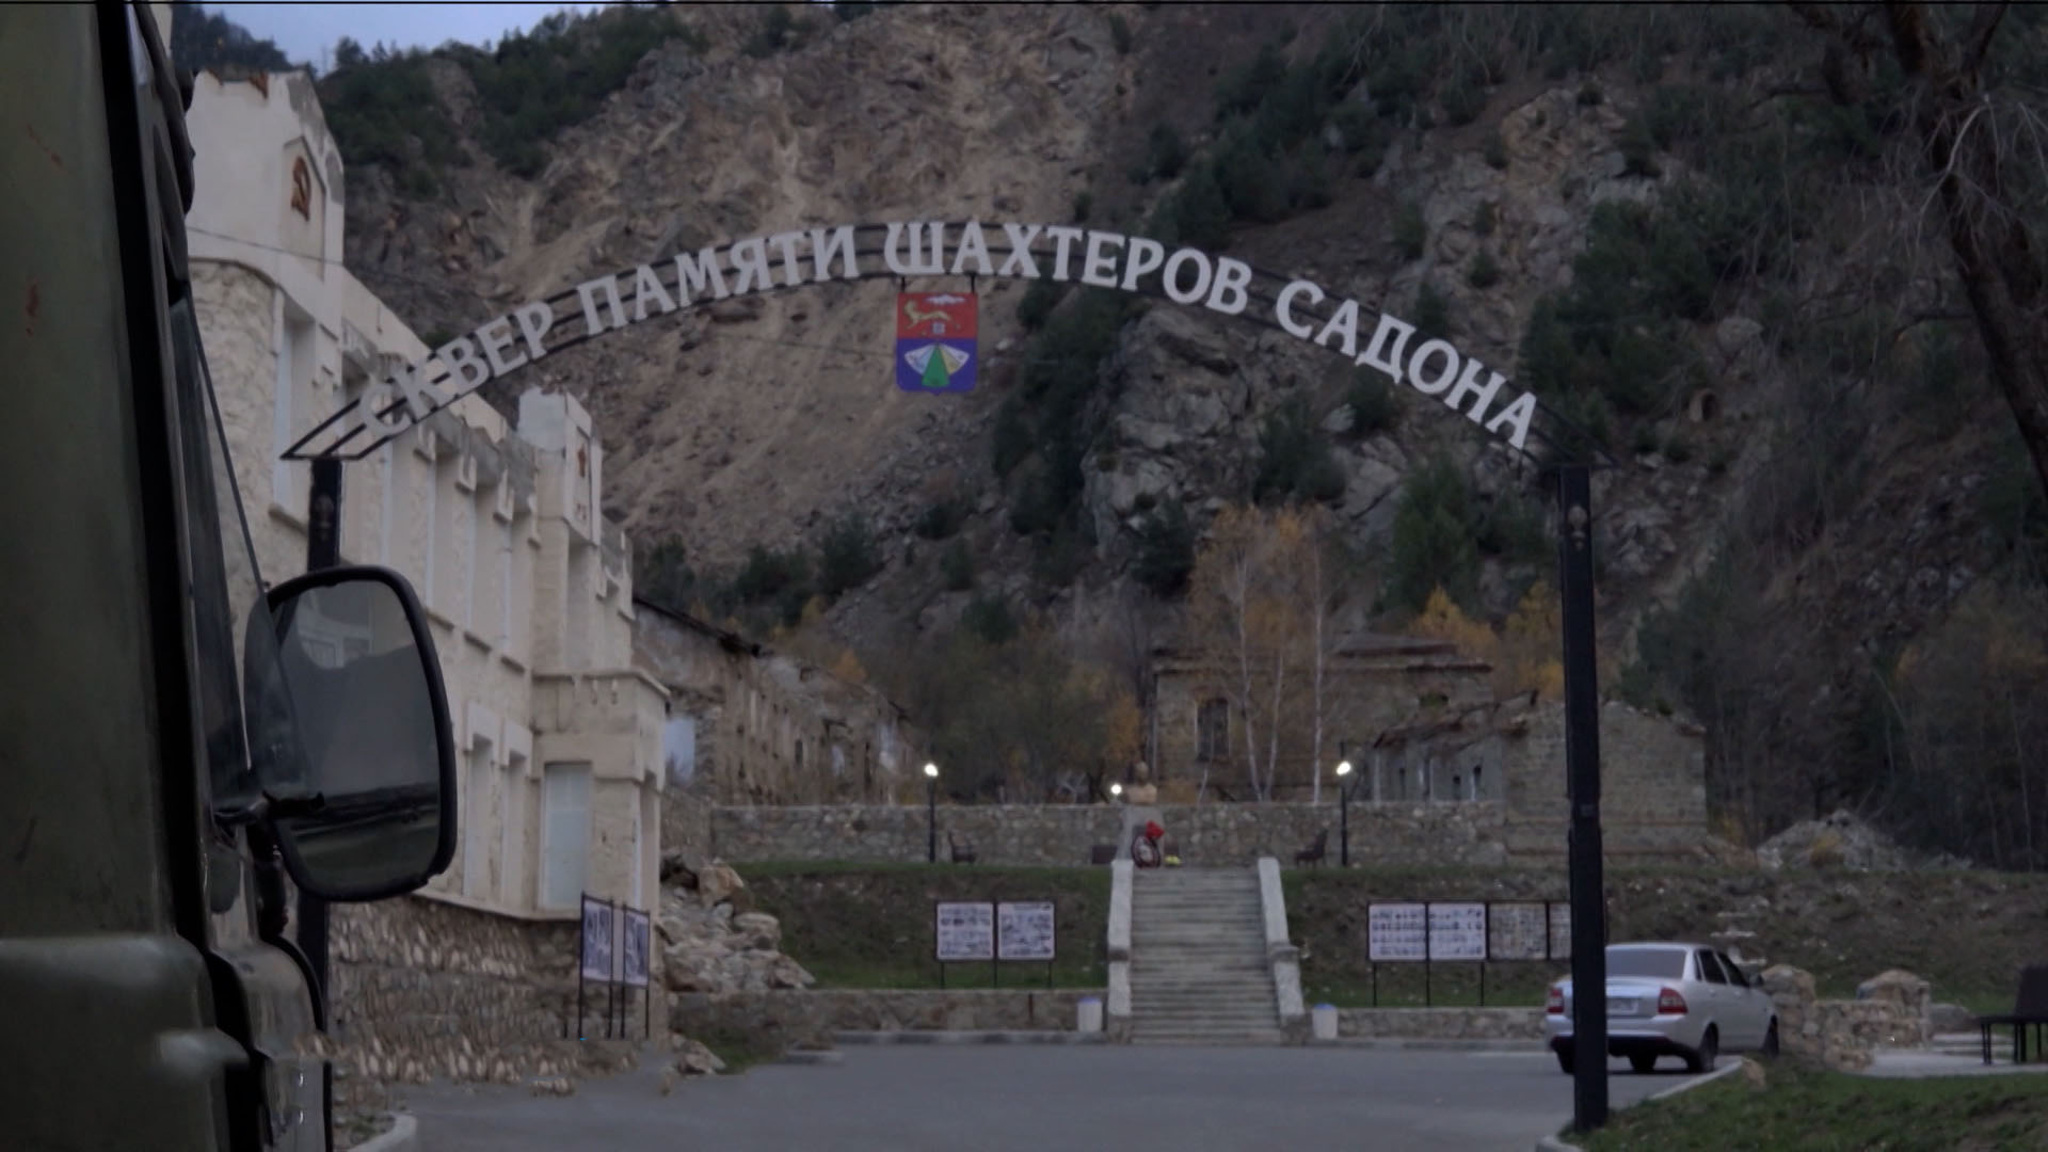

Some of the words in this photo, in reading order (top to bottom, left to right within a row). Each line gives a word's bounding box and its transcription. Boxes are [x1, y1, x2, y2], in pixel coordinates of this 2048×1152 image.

[359, 302, 553, 438] СКВЕР
[577, 225, 859, 335] ПАМЯТИ
[884, 222, 1253, 317] ШАХТЕРОВ
[1275, 280, 1538, 450] САДОНА
